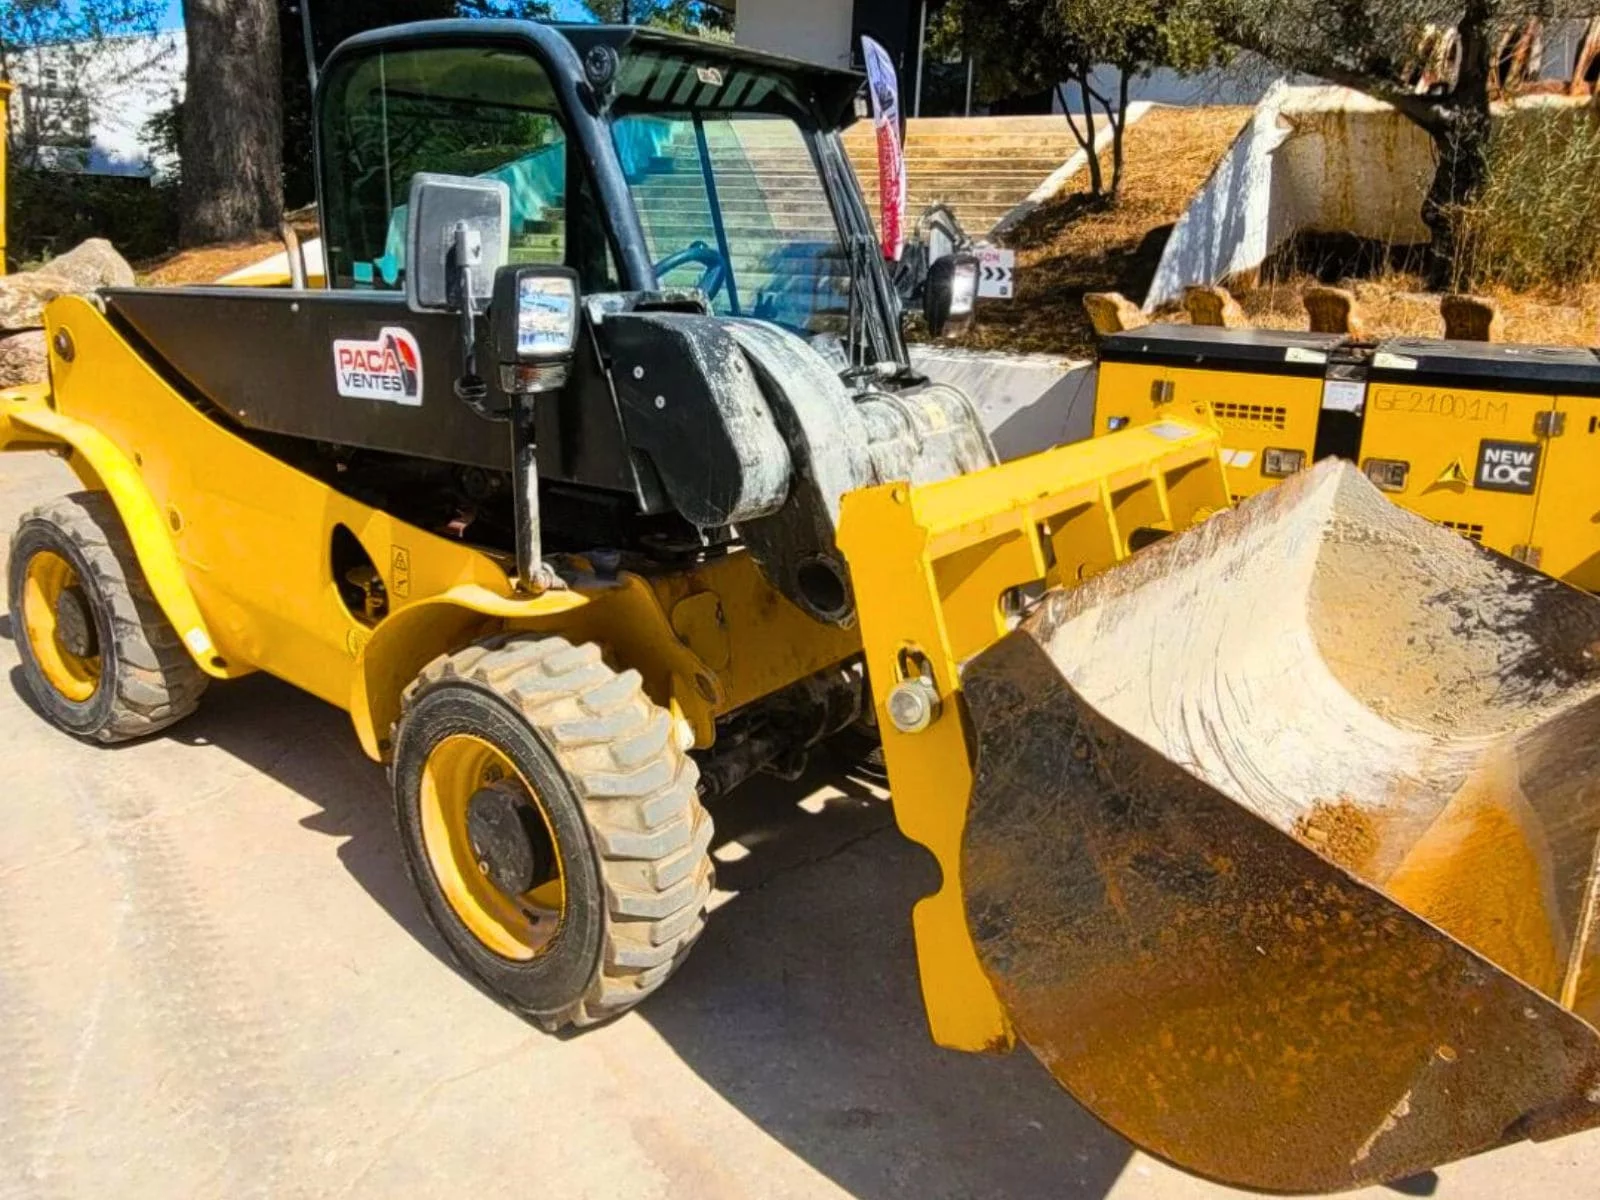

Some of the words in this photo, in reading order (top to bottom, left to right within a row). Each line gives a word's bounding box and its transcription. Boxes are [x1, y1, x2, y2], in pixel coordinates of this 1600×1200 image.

[339, 348, 398, 373] PACA
[342, 373, 402, 391] VENTES
[1484, 448, 1535, 466] NEW
[1481, 463, 1533, 486] LOC
